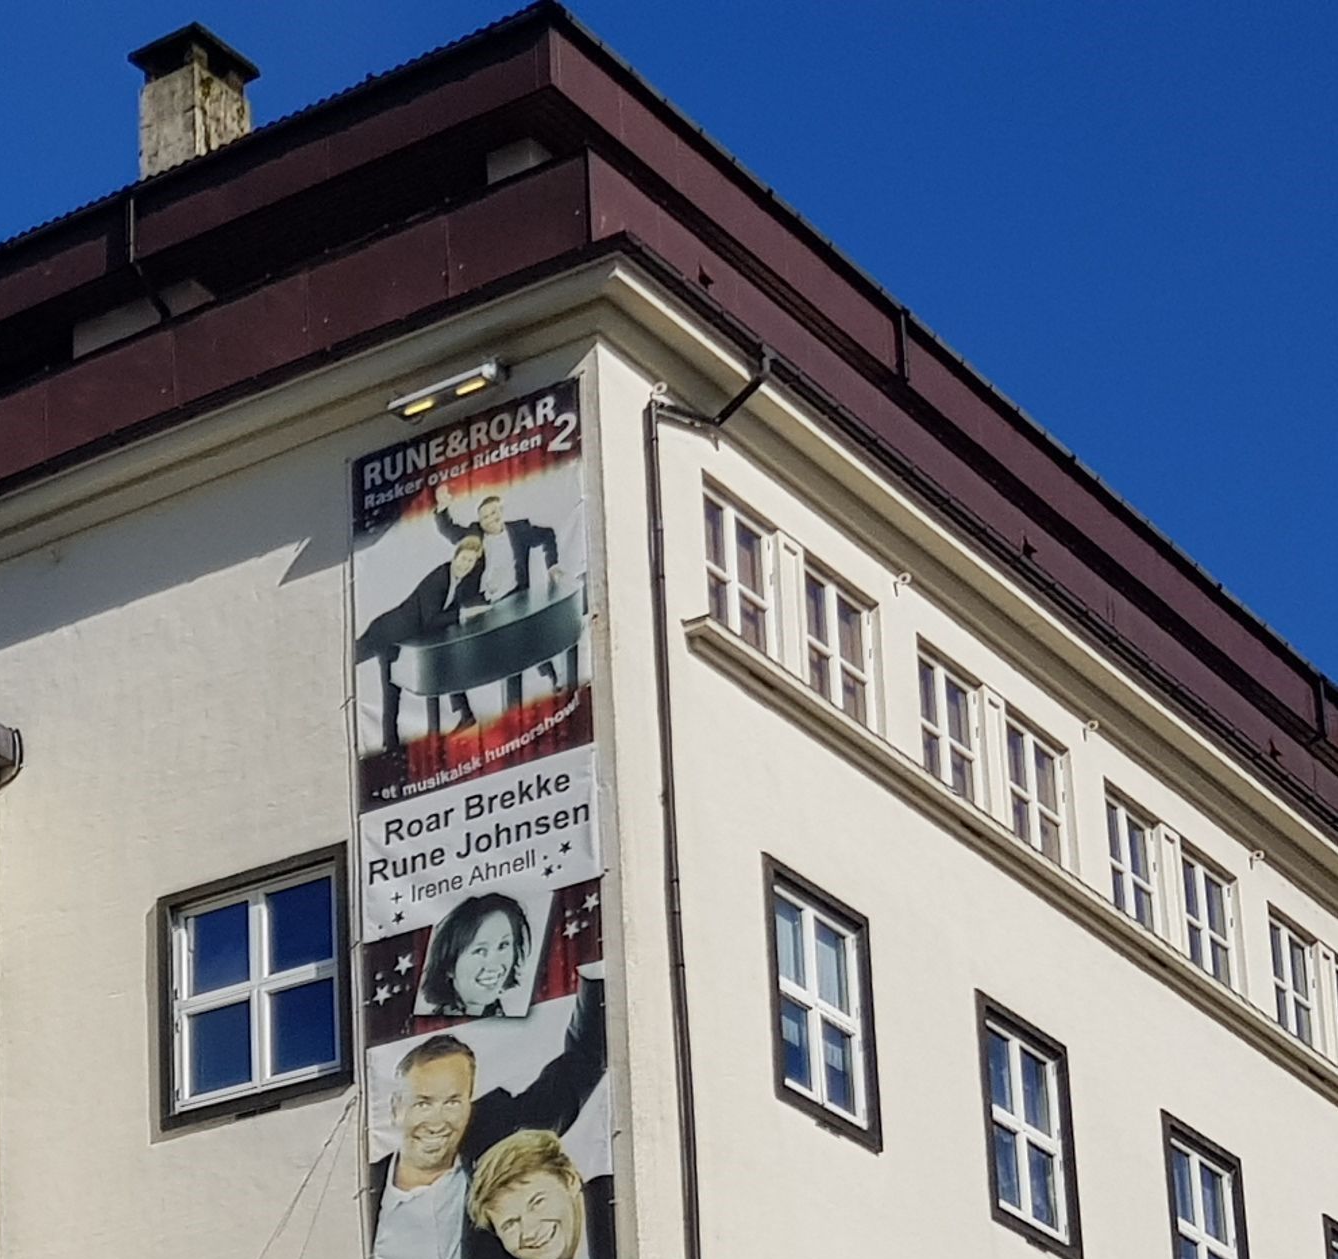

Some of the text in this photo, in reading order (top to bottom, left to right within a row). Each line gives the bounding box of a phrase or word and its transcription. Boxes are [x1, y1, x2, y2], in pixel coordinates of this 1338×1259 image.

[364, 396, 556, 490] RUNE&ROAR
[547, 412, 577, 452] 2
[364, 434, 542, 510] Rasker over Ricksen
[384, 773, 571, 846] Roar Brekke
[402, 755, 483, 796] musikalsk
[368, 803, 590, 886] Rune Johnsen
[411, 875, 464, 902] Irene
[468, 849, 537, 887] Ahnell
